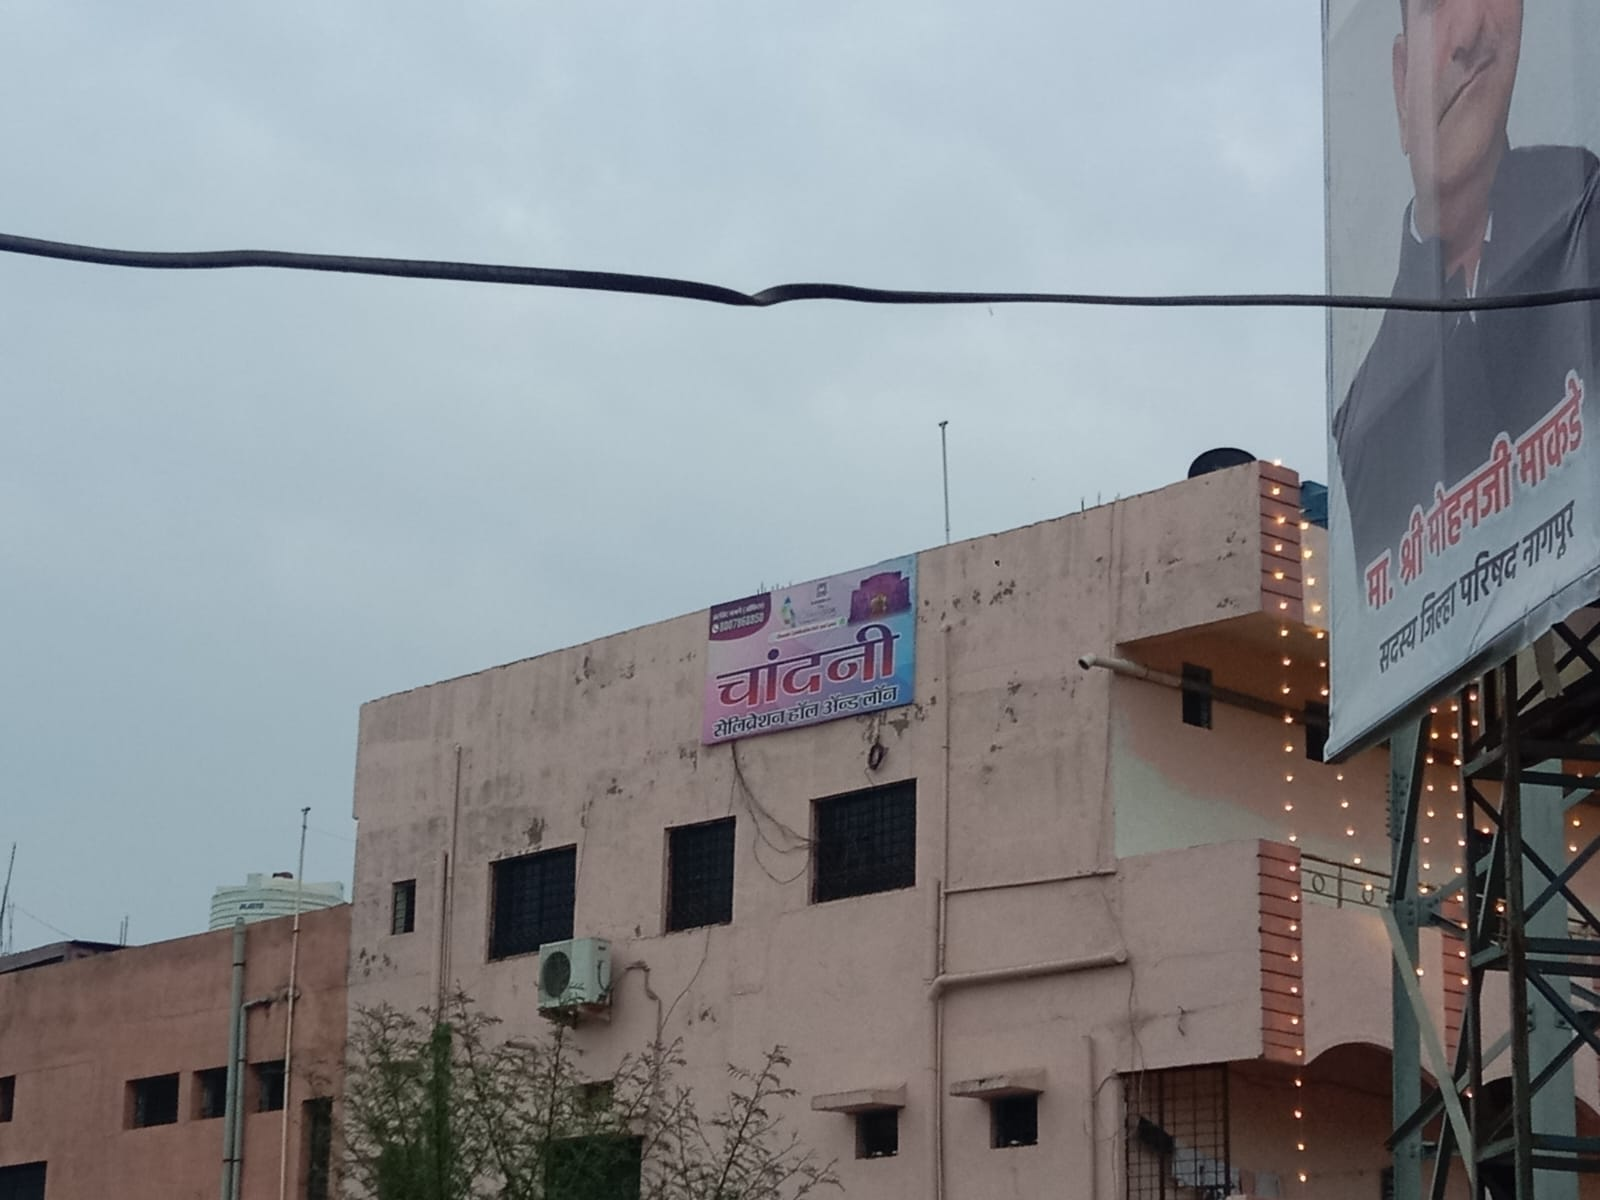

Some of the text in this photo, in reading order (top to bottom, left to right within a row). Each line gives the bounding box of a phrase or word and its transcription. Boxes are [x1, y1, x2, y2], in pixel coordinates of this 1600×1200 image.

[1366, 376, 1584, 610] मा. श्री मोहनजी माकडे
[1379, 616, 1418, 674] सदस्य
[1420, 581, 1457, 643] जिल्हा
[1460, 541, 1519, 607] परिषद
[713, 708, 785, 738] सेलिब्रेशन
[788, 701, 819, 723] हॉल
[862, 685, 898, 707] लॉन
[716, 624, 900, 707] चांदनी
